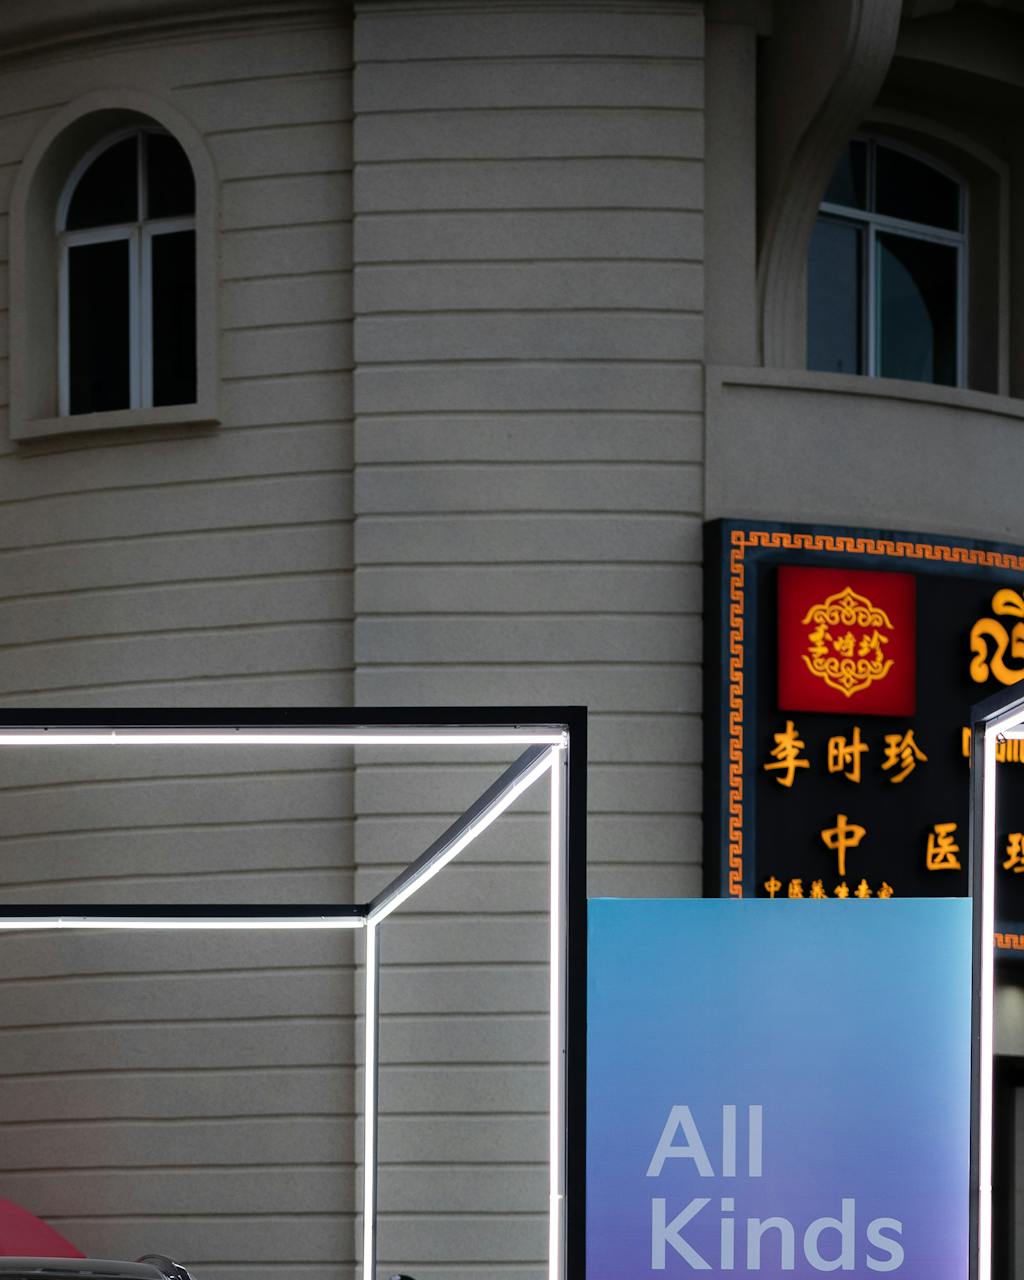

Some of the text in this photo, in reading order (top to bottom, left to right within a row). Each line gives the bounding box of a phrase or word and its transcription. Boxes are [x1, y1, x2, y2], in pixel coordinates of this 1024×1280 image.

[764, 720, 928, 787] 李时珍
[646, 1105, 764, 1178] All
[650, 1197, 905, 1272] Kinds
